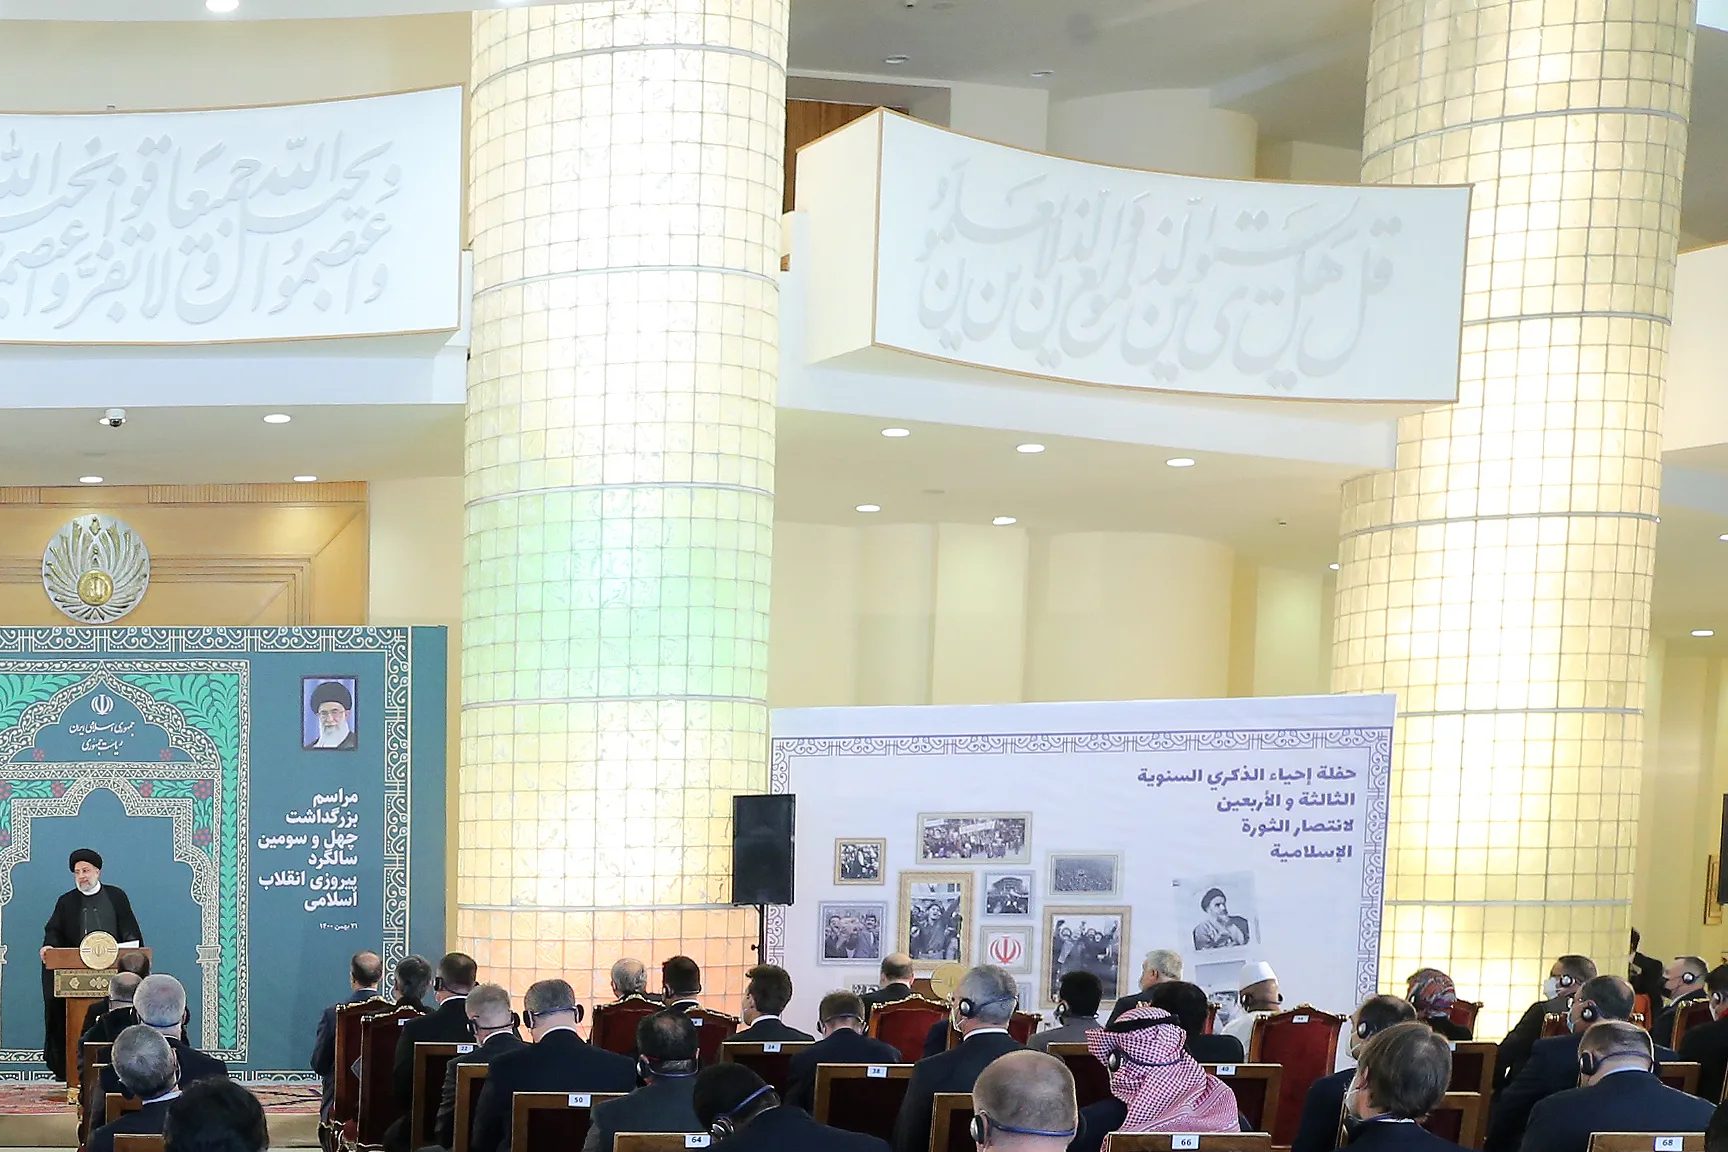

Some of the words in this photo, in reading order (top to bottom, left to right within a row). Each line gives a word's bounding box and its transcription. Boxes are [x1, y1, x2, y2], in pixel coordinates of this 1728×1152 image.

[1317, 766, 1357, 780] حفلة
[313, 788, 359, 807] مراسم
[1285, 797, 1294, 811] و
[1299, 792, 1355, 806] الثالثة
[286, 808, 358, 828] بزرگداشت
[1242, 818, 1289, 837] الثورة
[1294, 819, 1354, 836] لانتصار
[258, 833, 308, 849] سومین
[312, 835, 319, 848] و
[324, 830, 358, 850] چهل
[308, 849, 358, 869] سالگرد
[1270, 845, 1352, 862] الإسلامية
[258, 870, 305, 890] انقلاب
[310, 873, 357, 890] پیروزی
[304, 890, 357, 911] اسلامی
